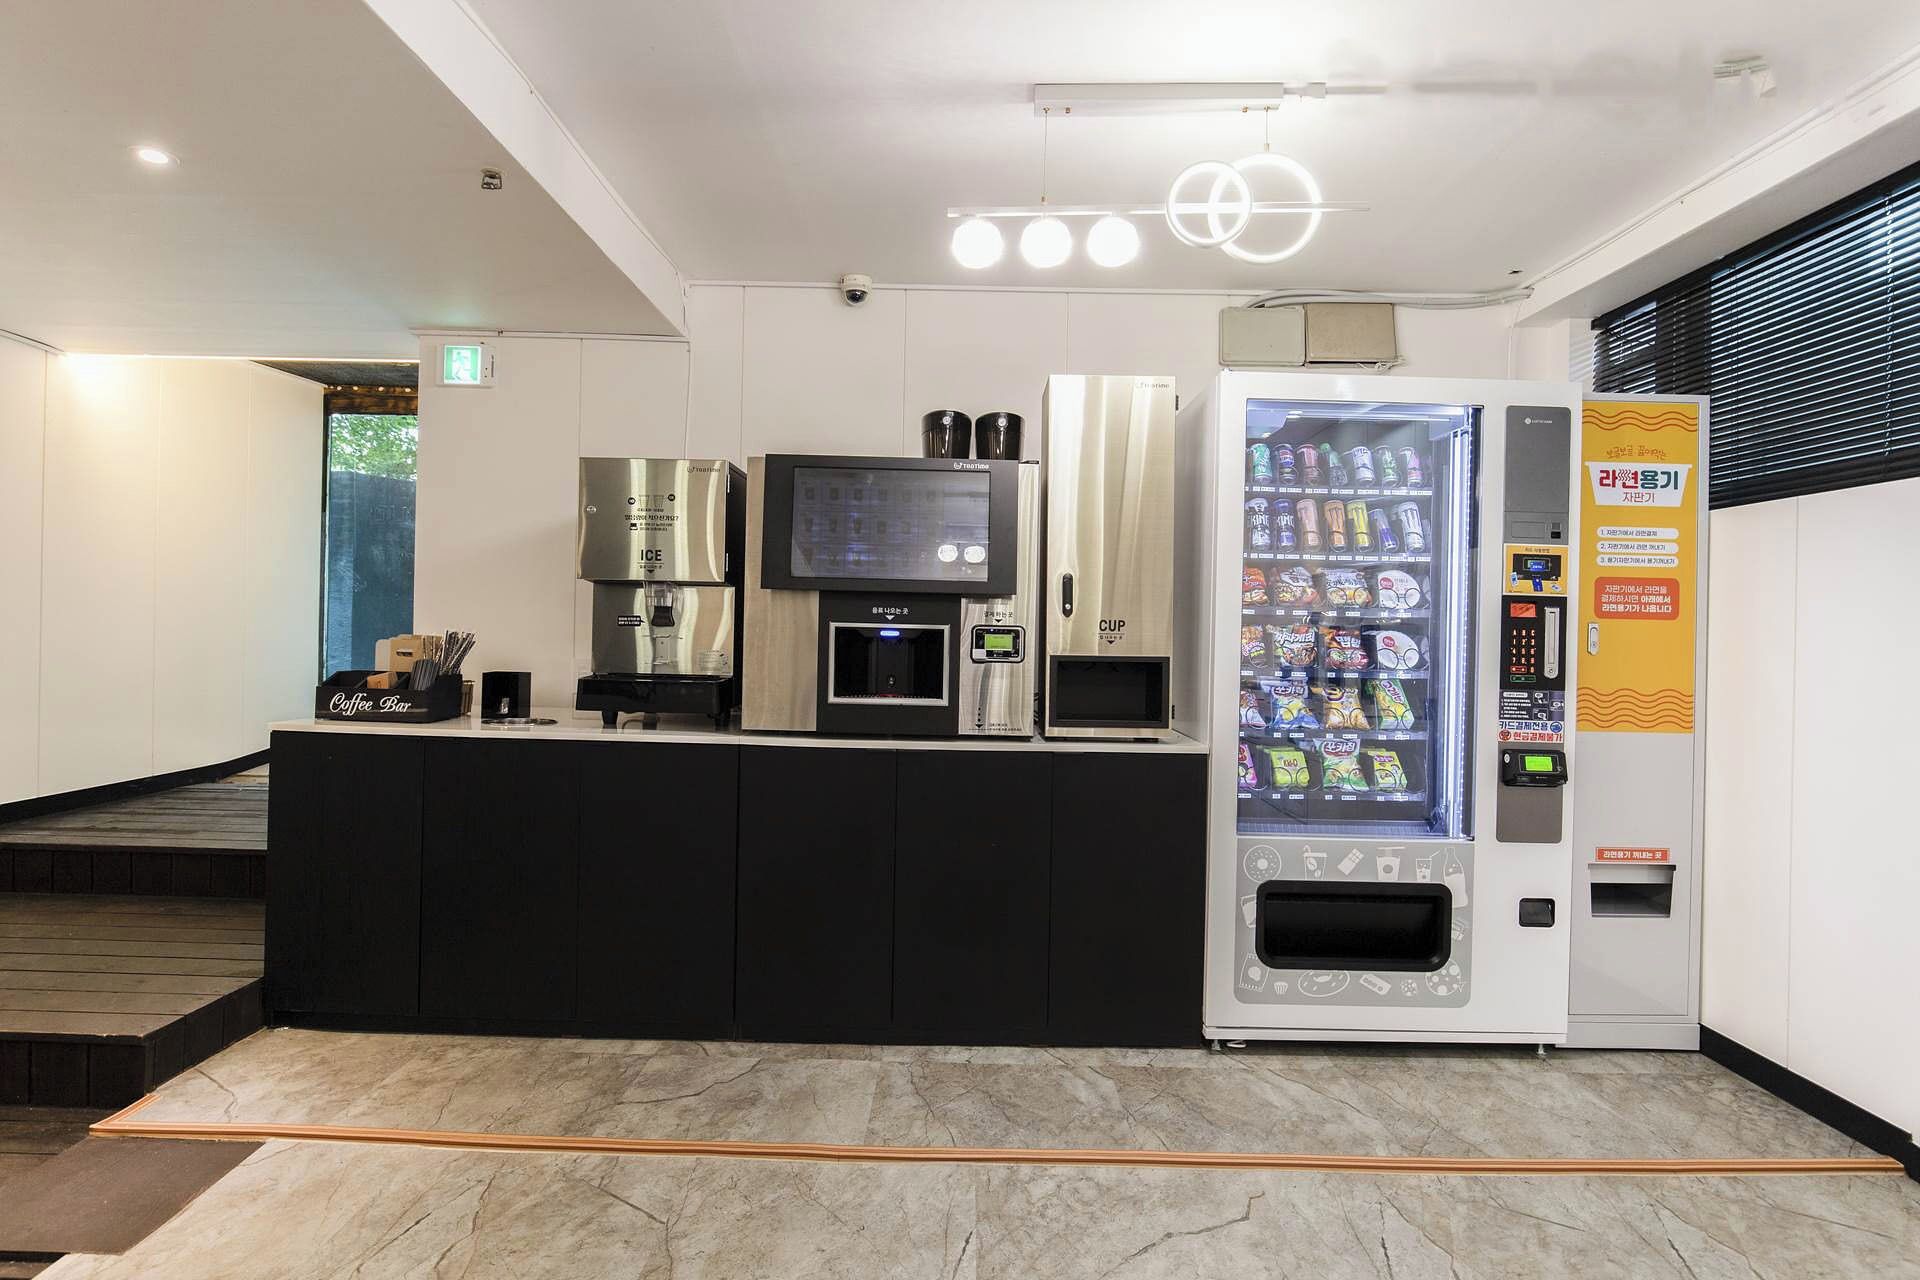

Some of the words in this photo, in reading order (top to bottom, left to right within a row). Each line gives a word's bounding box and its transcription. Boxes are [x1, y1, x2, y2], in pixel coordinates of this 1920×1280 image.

[1623, 492, 1655, 503] 자판기
[640, 549, 663, 561] ICE
[884, 607, 902, 615] 나오는
[1099, 619, 1126, 632] CUP
[330, 692, 374, 716] Coffee
[380, 695, 412, 713] Bar
[1326, 741, 1357, 753] 포카칩
